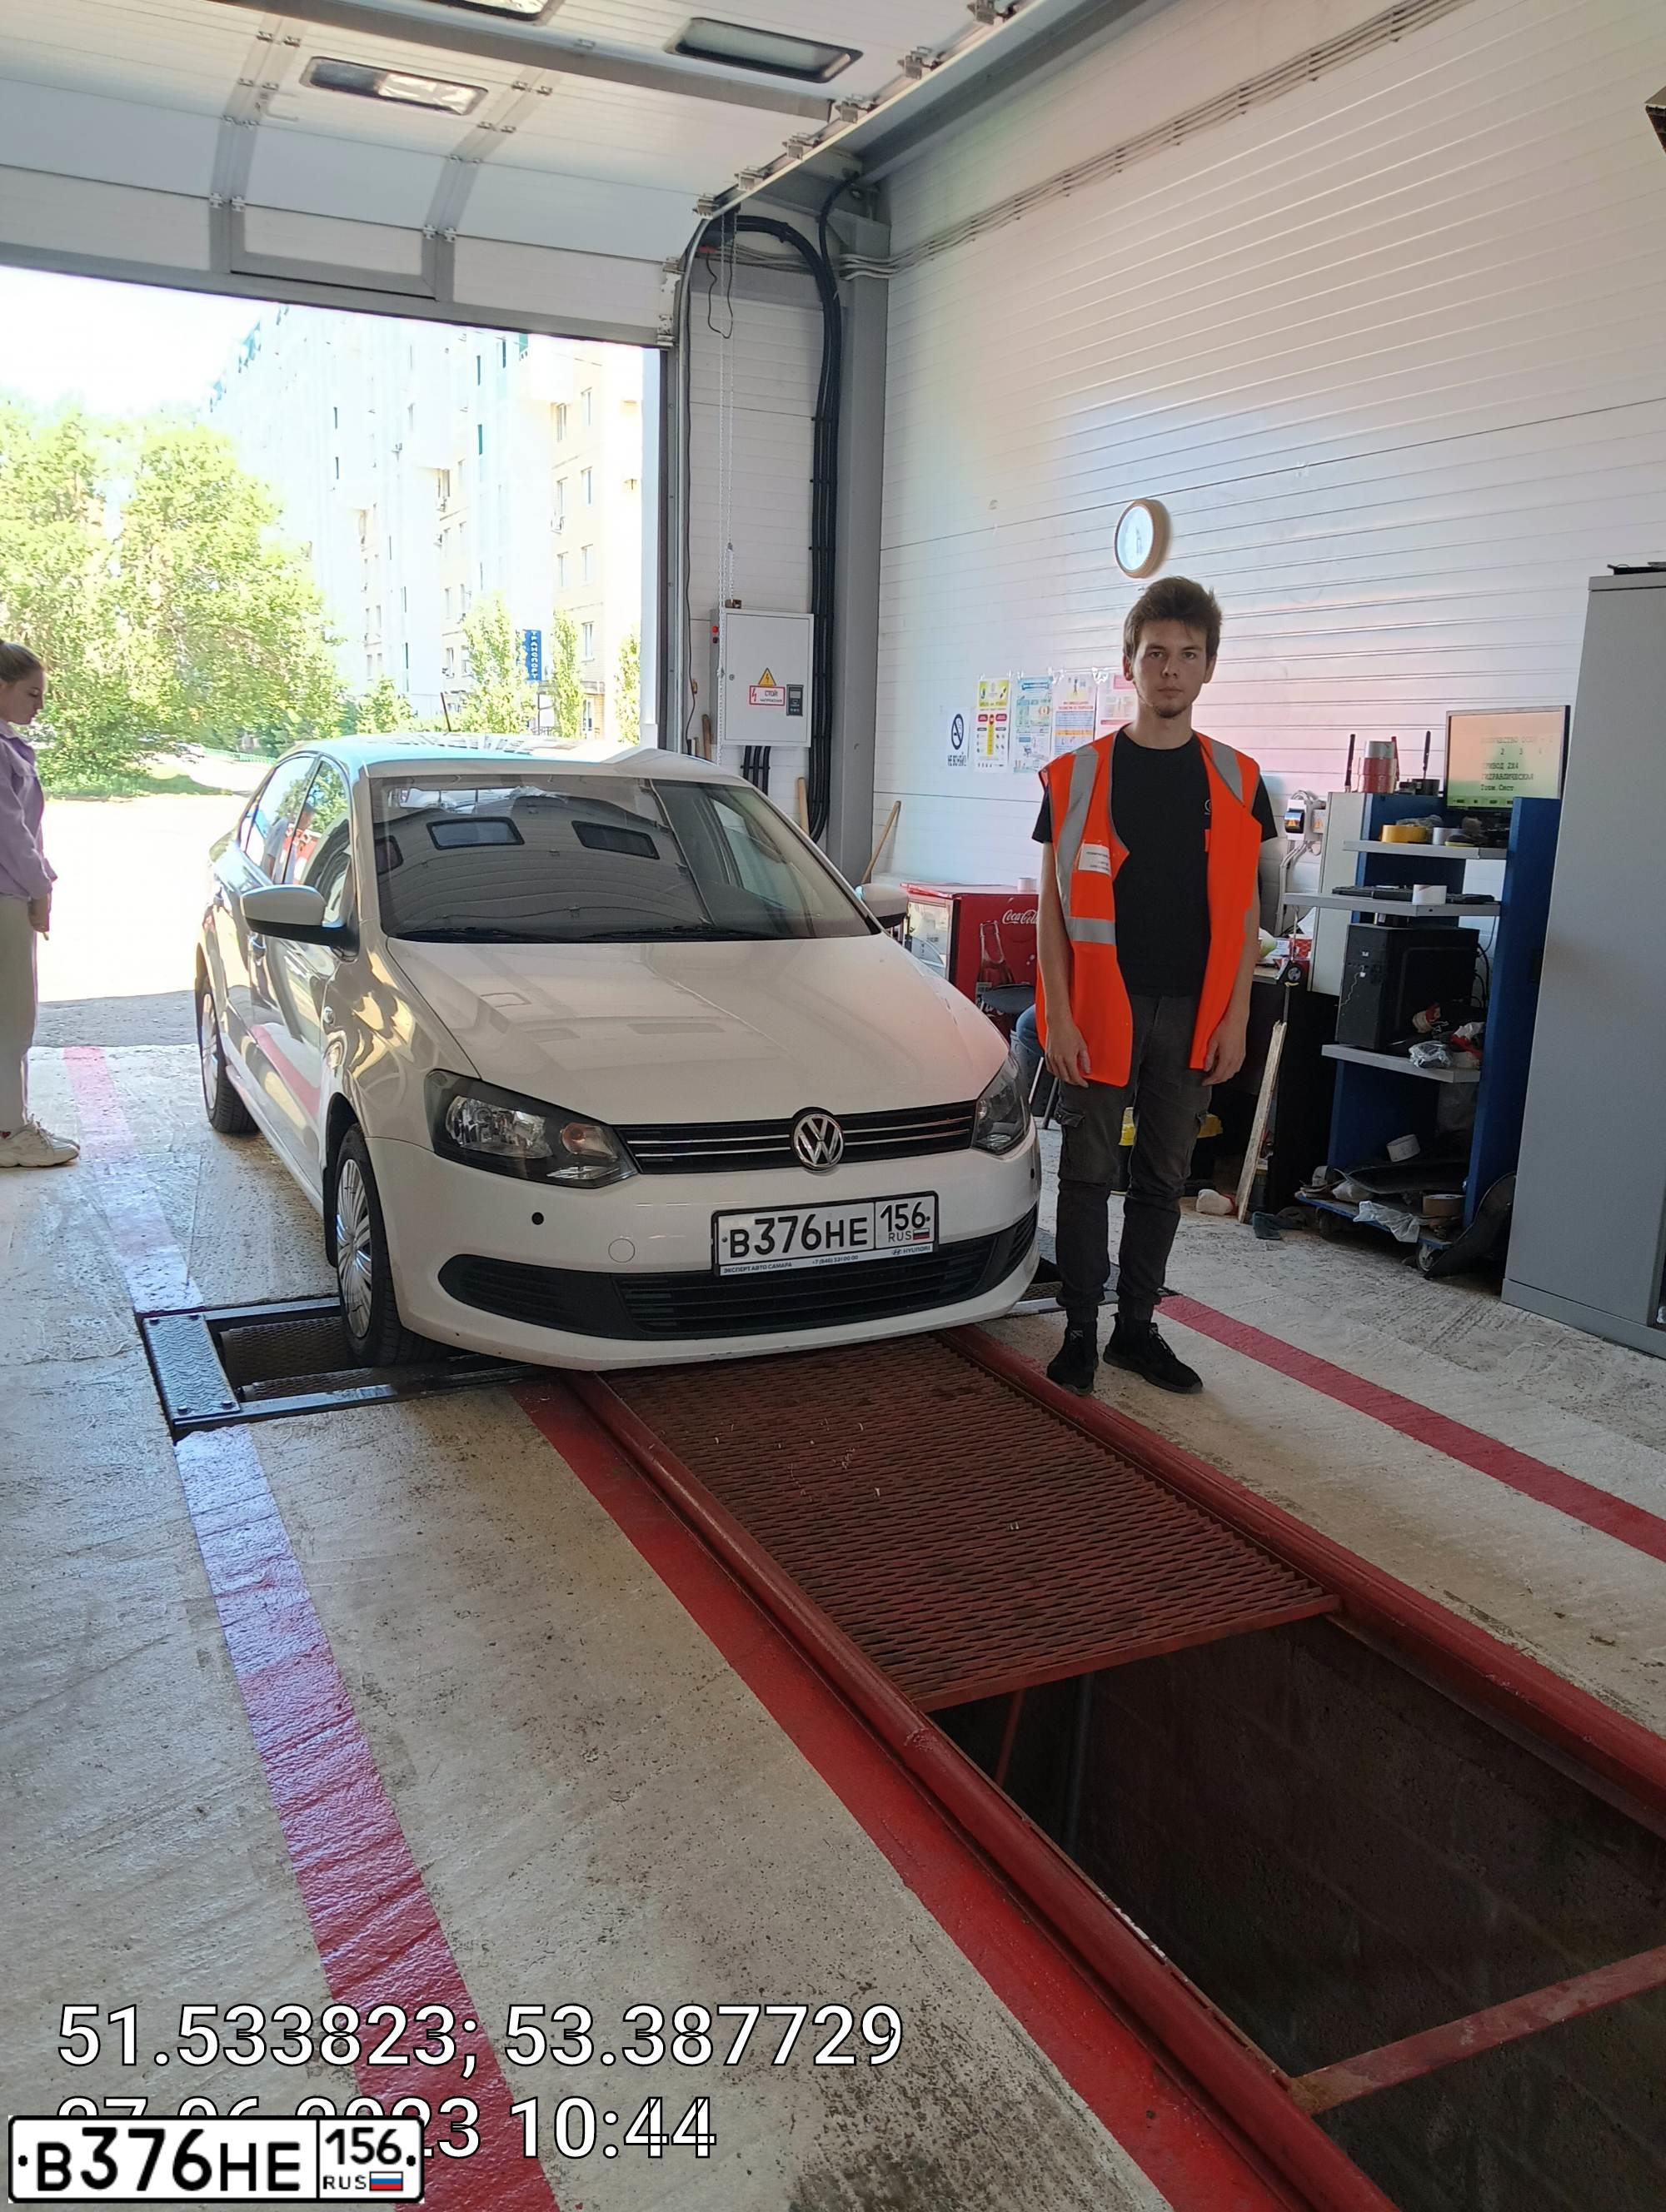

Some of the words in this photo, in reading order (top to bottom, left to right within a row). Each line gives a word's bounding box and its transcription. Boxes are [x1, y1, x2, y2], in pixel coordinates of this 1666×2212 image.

[880, 1202, 925, 1233] 156
[888, 1230, 912, 1243] RUS
[903, 1245, 930, 1254] HYUNDAI
